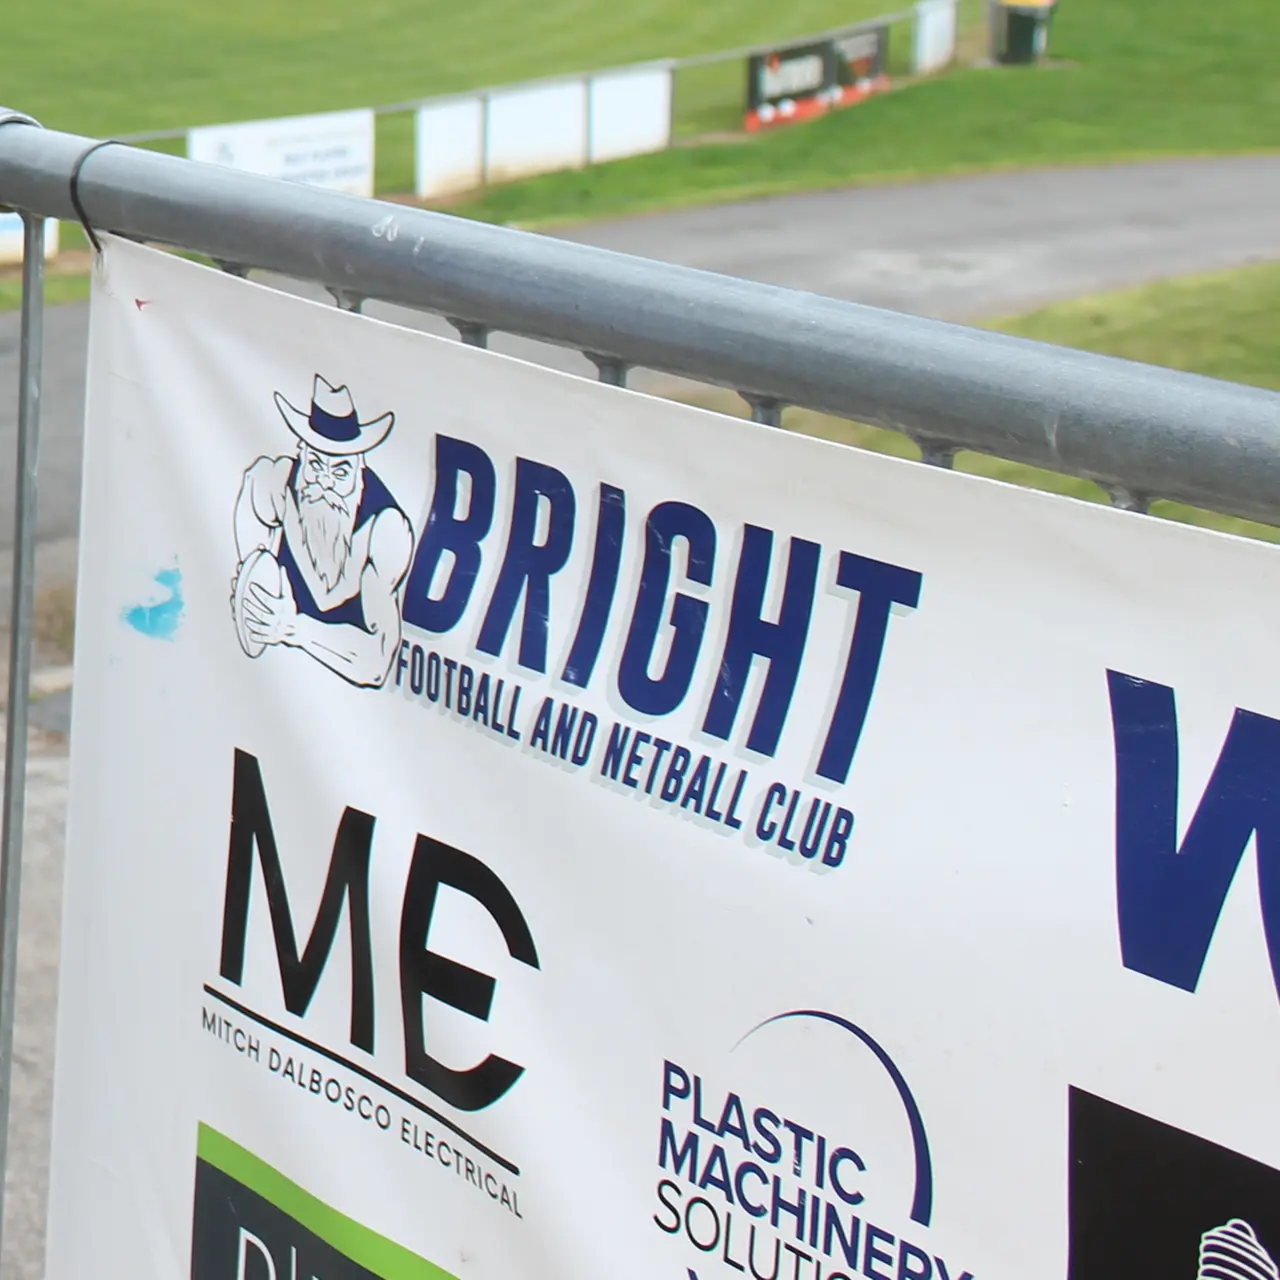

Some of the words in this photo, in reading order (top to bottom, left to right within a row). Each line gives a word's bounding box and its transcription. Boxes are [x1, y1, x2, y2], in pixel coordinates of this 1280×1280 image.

[402, 433, 924, 785] BRIGHT
[396, 640, 521, 741] FOOTBALL
[531, 696, 598, 768] AND
[601, 722, 748, 830] NETBALL
[755, 781, 855, 869] CLUB
[220, 747, 541, 1112] ME
[202, 1006, 260, 1062] MITCH
[268, 1047, 392, 1130] DALBOSCO
[401, 1117, 524, 1220] ELECTRICAL
[662, 1059, 867, 1205] PLASTIC
